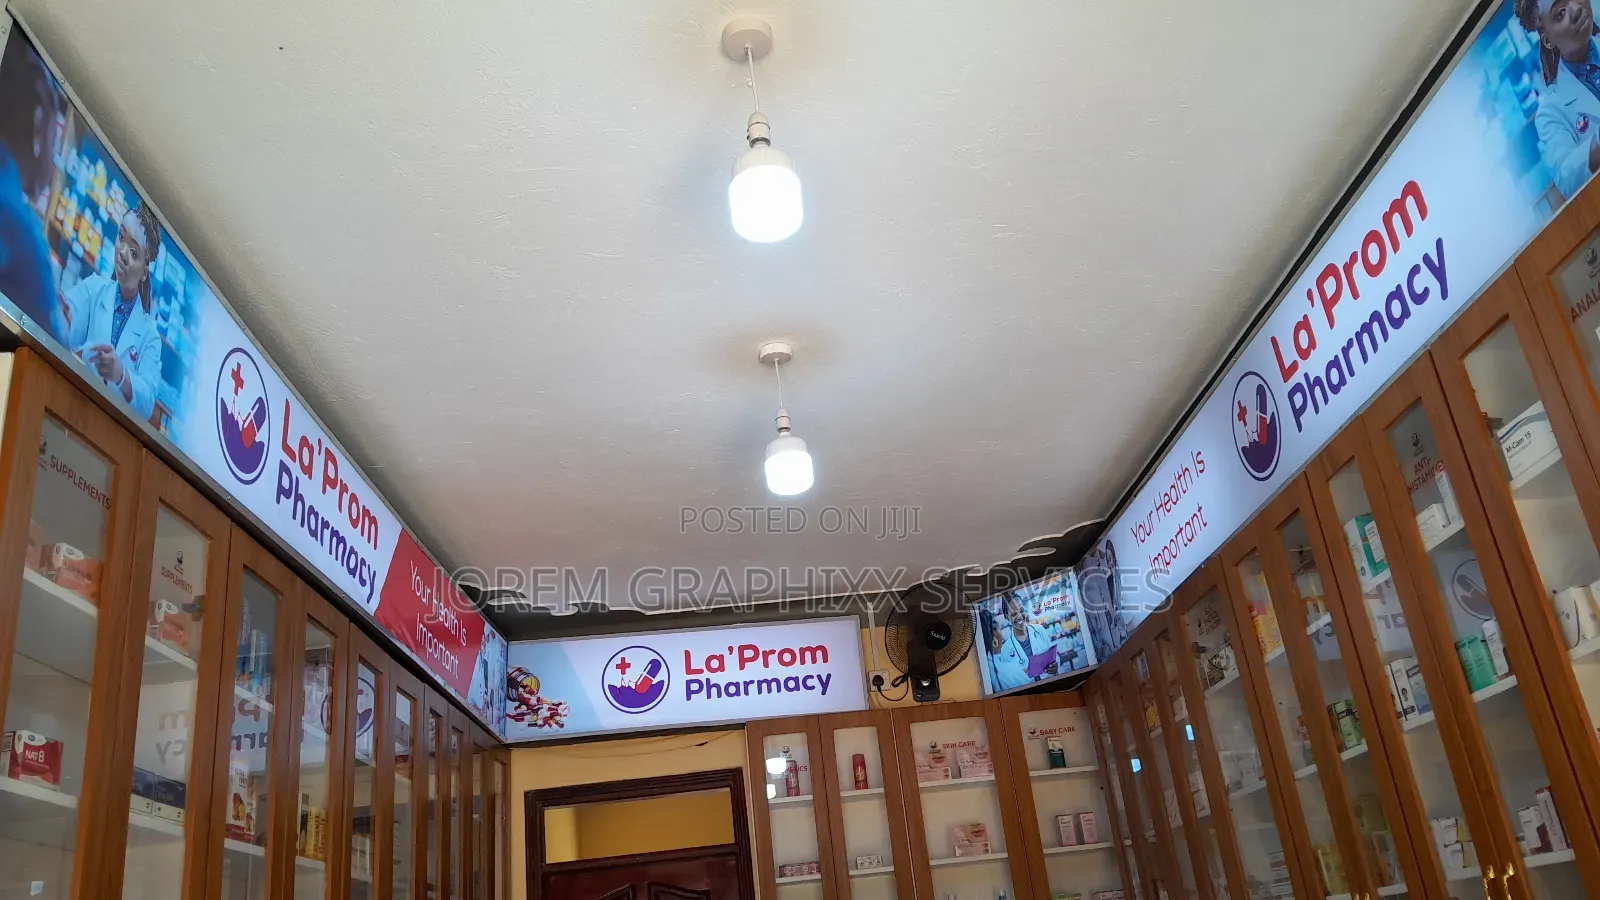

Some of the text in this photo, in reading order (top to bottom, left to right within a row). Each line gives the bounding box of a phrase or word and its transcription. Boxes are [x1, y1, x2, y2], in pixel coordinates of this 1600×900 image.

[1270, 179, 1428, 382] La'Prom
[1570, 279, 1600, 324] ANAL
[1287, 237, 1449, 433] Pharmacy
[1524, 430, 1532, 442] 15
[49, 454, 111, 511] SUPPLEMENTS
[280, 397, 379, 550] La'Prom
[1414, 455, 1432, 476] ANTI-
[1130, 450, 1205, 548] Your Health Is
[275, 459, 377, 605] Pharmacy
[1148, 502, 1208, 580] Important
[160, 565, 193, 595] SUPPLEMENTS
[410, 560, 467, 647] Your Health Is
[416, 612, 459, 679] Important
[684, 643, 829, 675] La'Prom
[685, 673, 832, 702] Pharmacy
[25, 750, 45, 763] NAT B
[958, 740, 976, 748] CARE
[1039, 726, 1076, 736] BABY CARE
